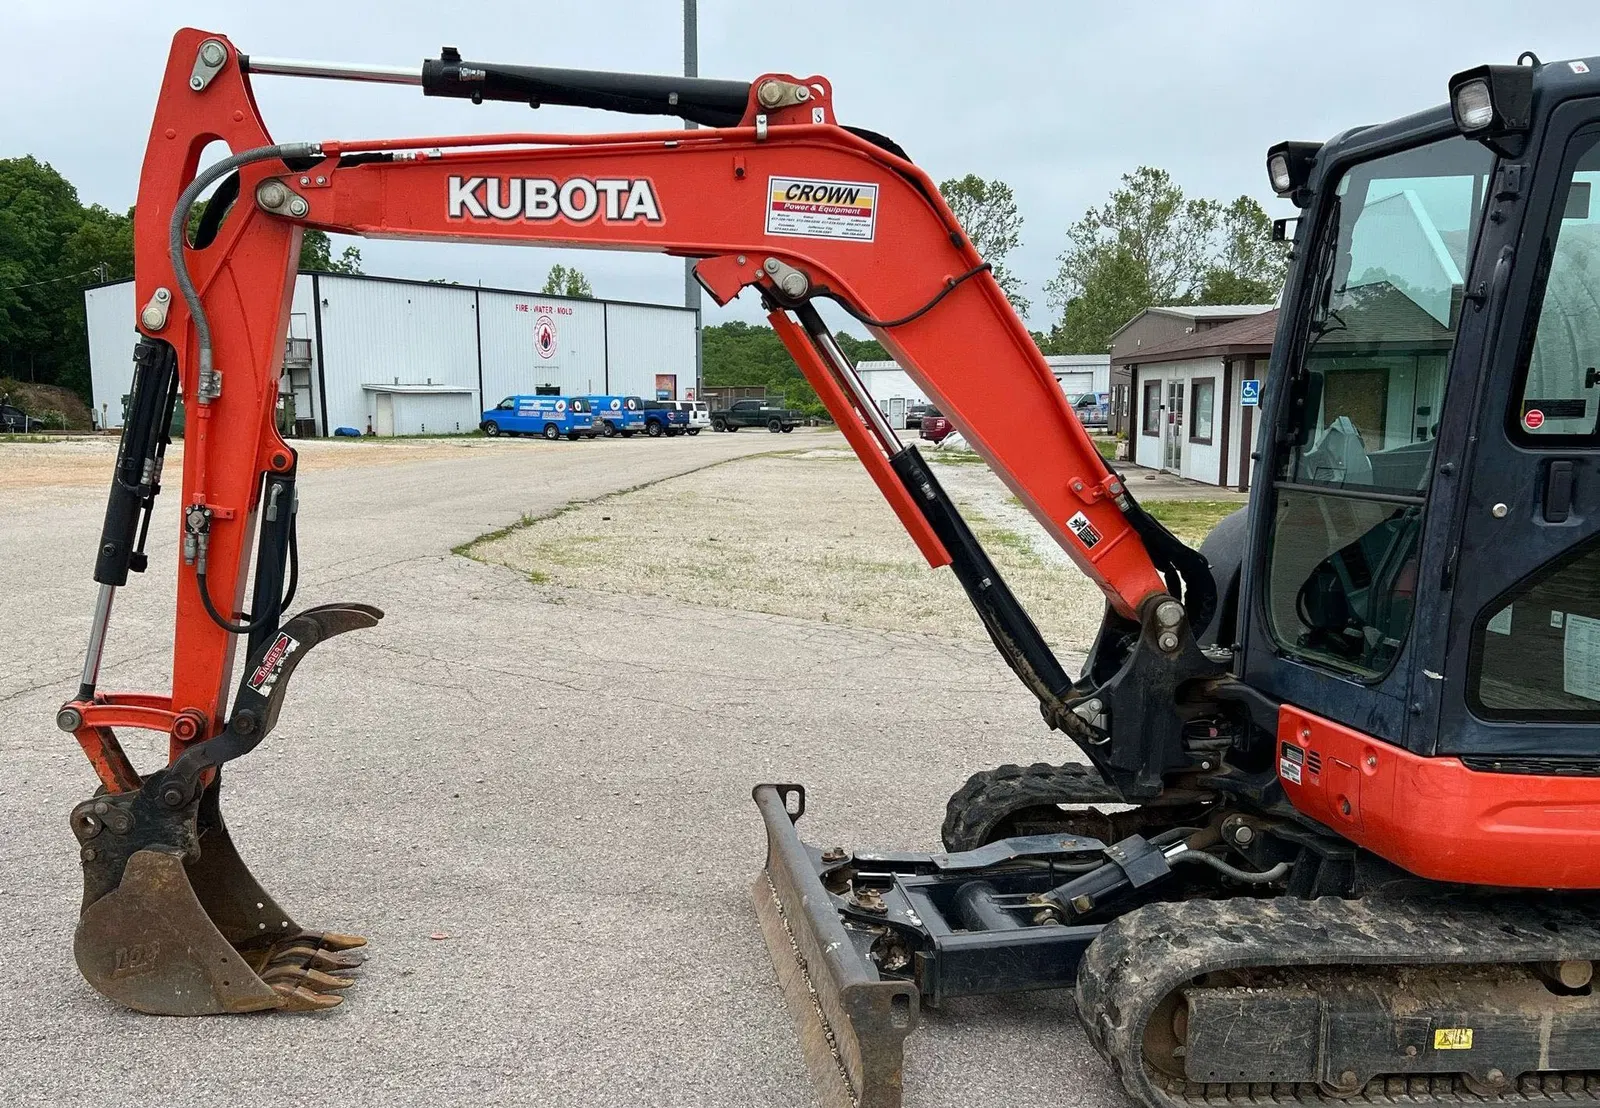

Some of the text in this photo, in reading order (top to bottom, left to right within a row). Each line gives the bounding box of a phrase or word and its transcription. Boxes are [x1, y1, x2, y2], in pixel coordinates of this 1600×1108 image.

[448, 175, 661, 222] KUBOTA
[785, 183, 860, 205] CROWN
[783, 203, 809, 212] Power
[818, 206, 861, 215] Equipment
[515, 304, 529, 312] FIRE
[534, 305, 553, 314] WATER
[557, 307, 573, 316] MOLD
[259, 647, 282, 677] DANGER
